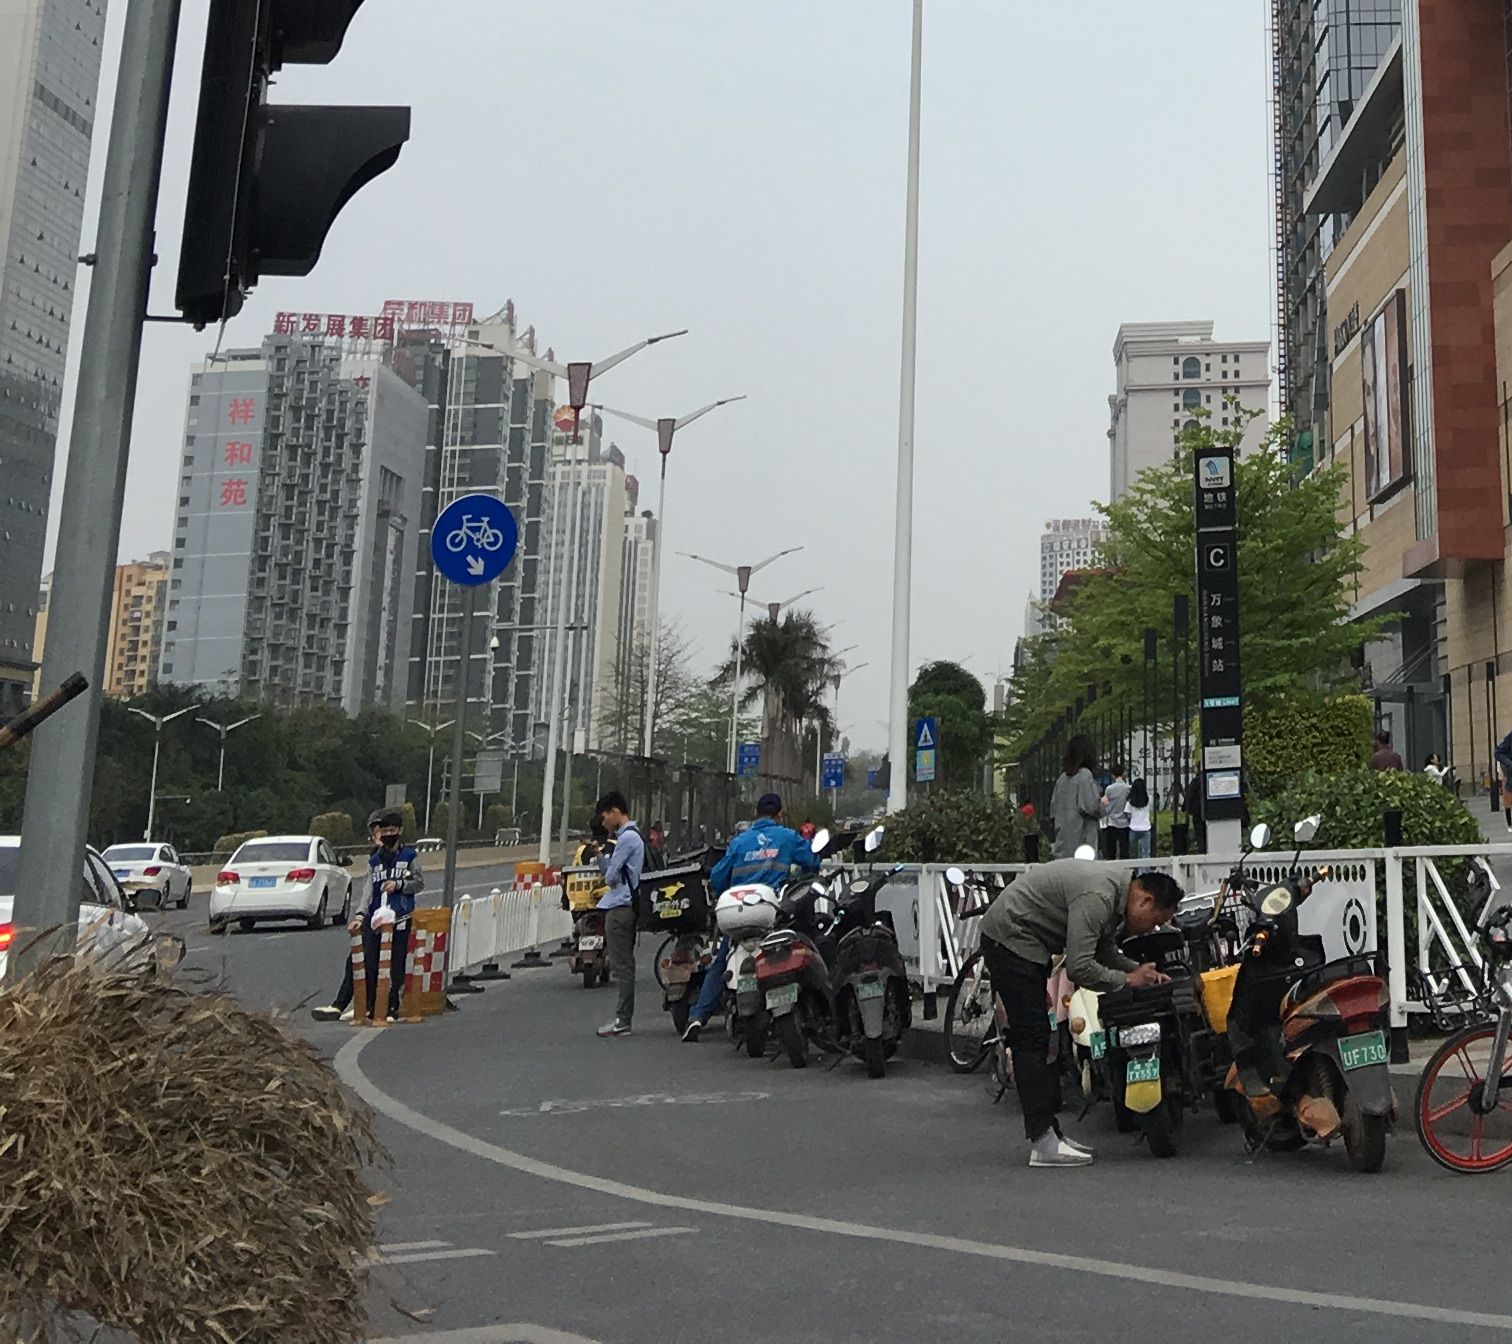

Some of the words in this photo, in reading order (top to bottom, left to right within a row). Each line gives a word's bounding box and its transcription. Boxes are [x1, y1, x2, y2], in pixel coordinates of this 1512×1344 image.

[274, 312, 395, 341] 新发展集团
[219, 398, 256, 506] 祥和苑
[1209, 547, 1225, 567] C
[1210, 593, 1224, 672] 万象城站
[1343, 1044, 1386, 1066] UF730
